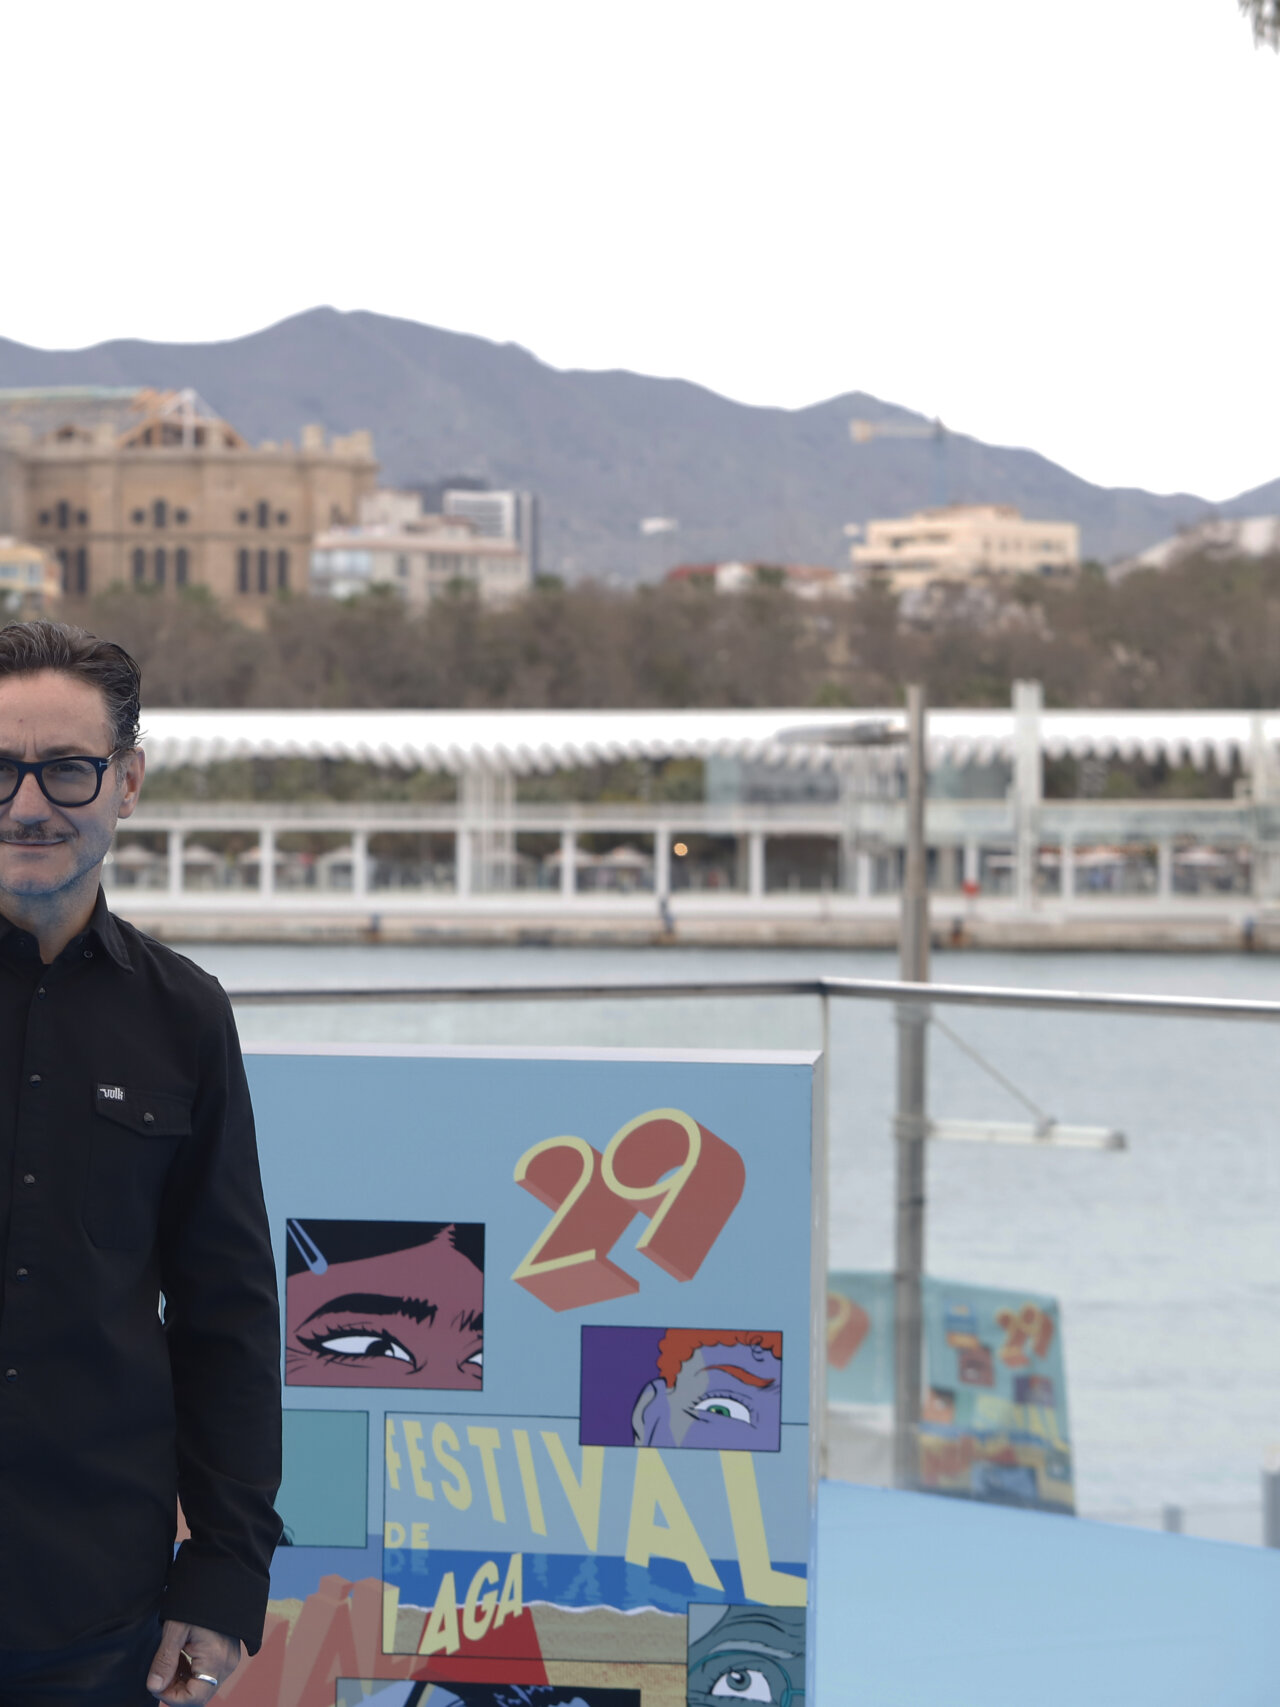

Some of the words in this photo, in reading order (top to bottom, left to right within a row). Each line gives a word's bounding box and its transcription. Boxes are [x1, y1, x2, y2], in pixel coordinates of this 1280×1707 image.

[511, 1107, 718, 1292] 29
[384, 1418, 808, 1607] FESTIVAL
[384, 1522, 430, 1550] DE
